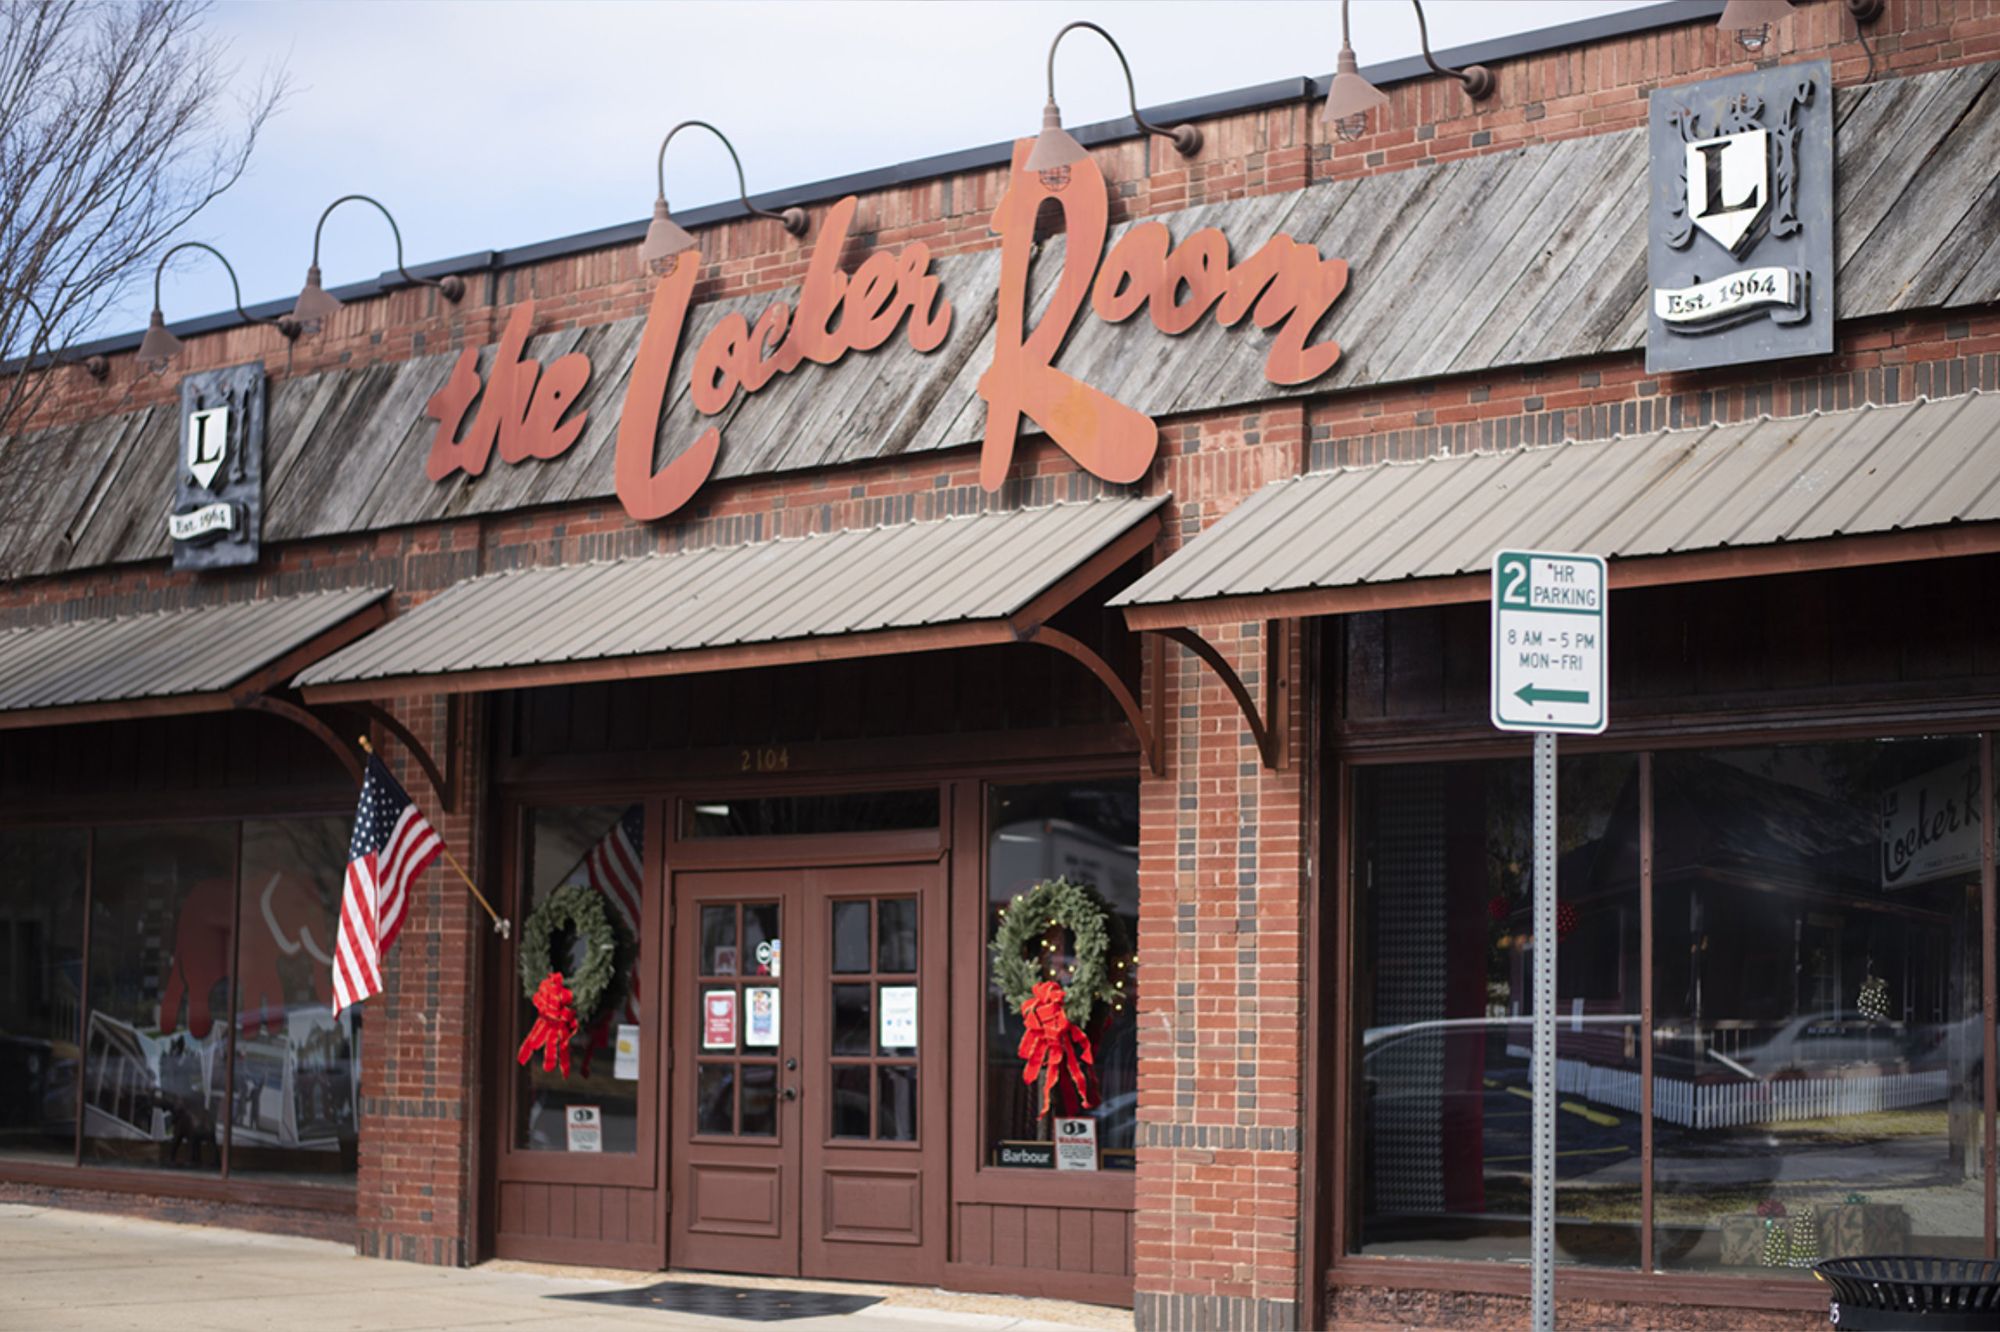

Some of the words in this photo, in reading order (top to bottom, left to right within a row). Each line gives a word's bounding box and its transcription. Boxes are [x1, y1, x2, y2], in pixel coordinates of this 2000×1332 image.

[1695, 140, 1759, 219] L
[1719, 272, 1776, 303] 1964
[427, 300, 591, 482] the
[615, 195, 952, 522] Locker
[976, 137, 1349, 493] Room
[193, 414, 221, 466] L
[1503, 561, 1527, 604] 2
[1553, 565, 1575, 583] HR
[1534, 586, 1596, 607] PARKING
[1507, 628, 1517, 645] 8
[1522, 630, 1543, 647] AM
[1575, 632, 1595, 650] PM
[741, 747, 789, 772] 2104
[1002, 1149, 1050, 1163] Barbour
